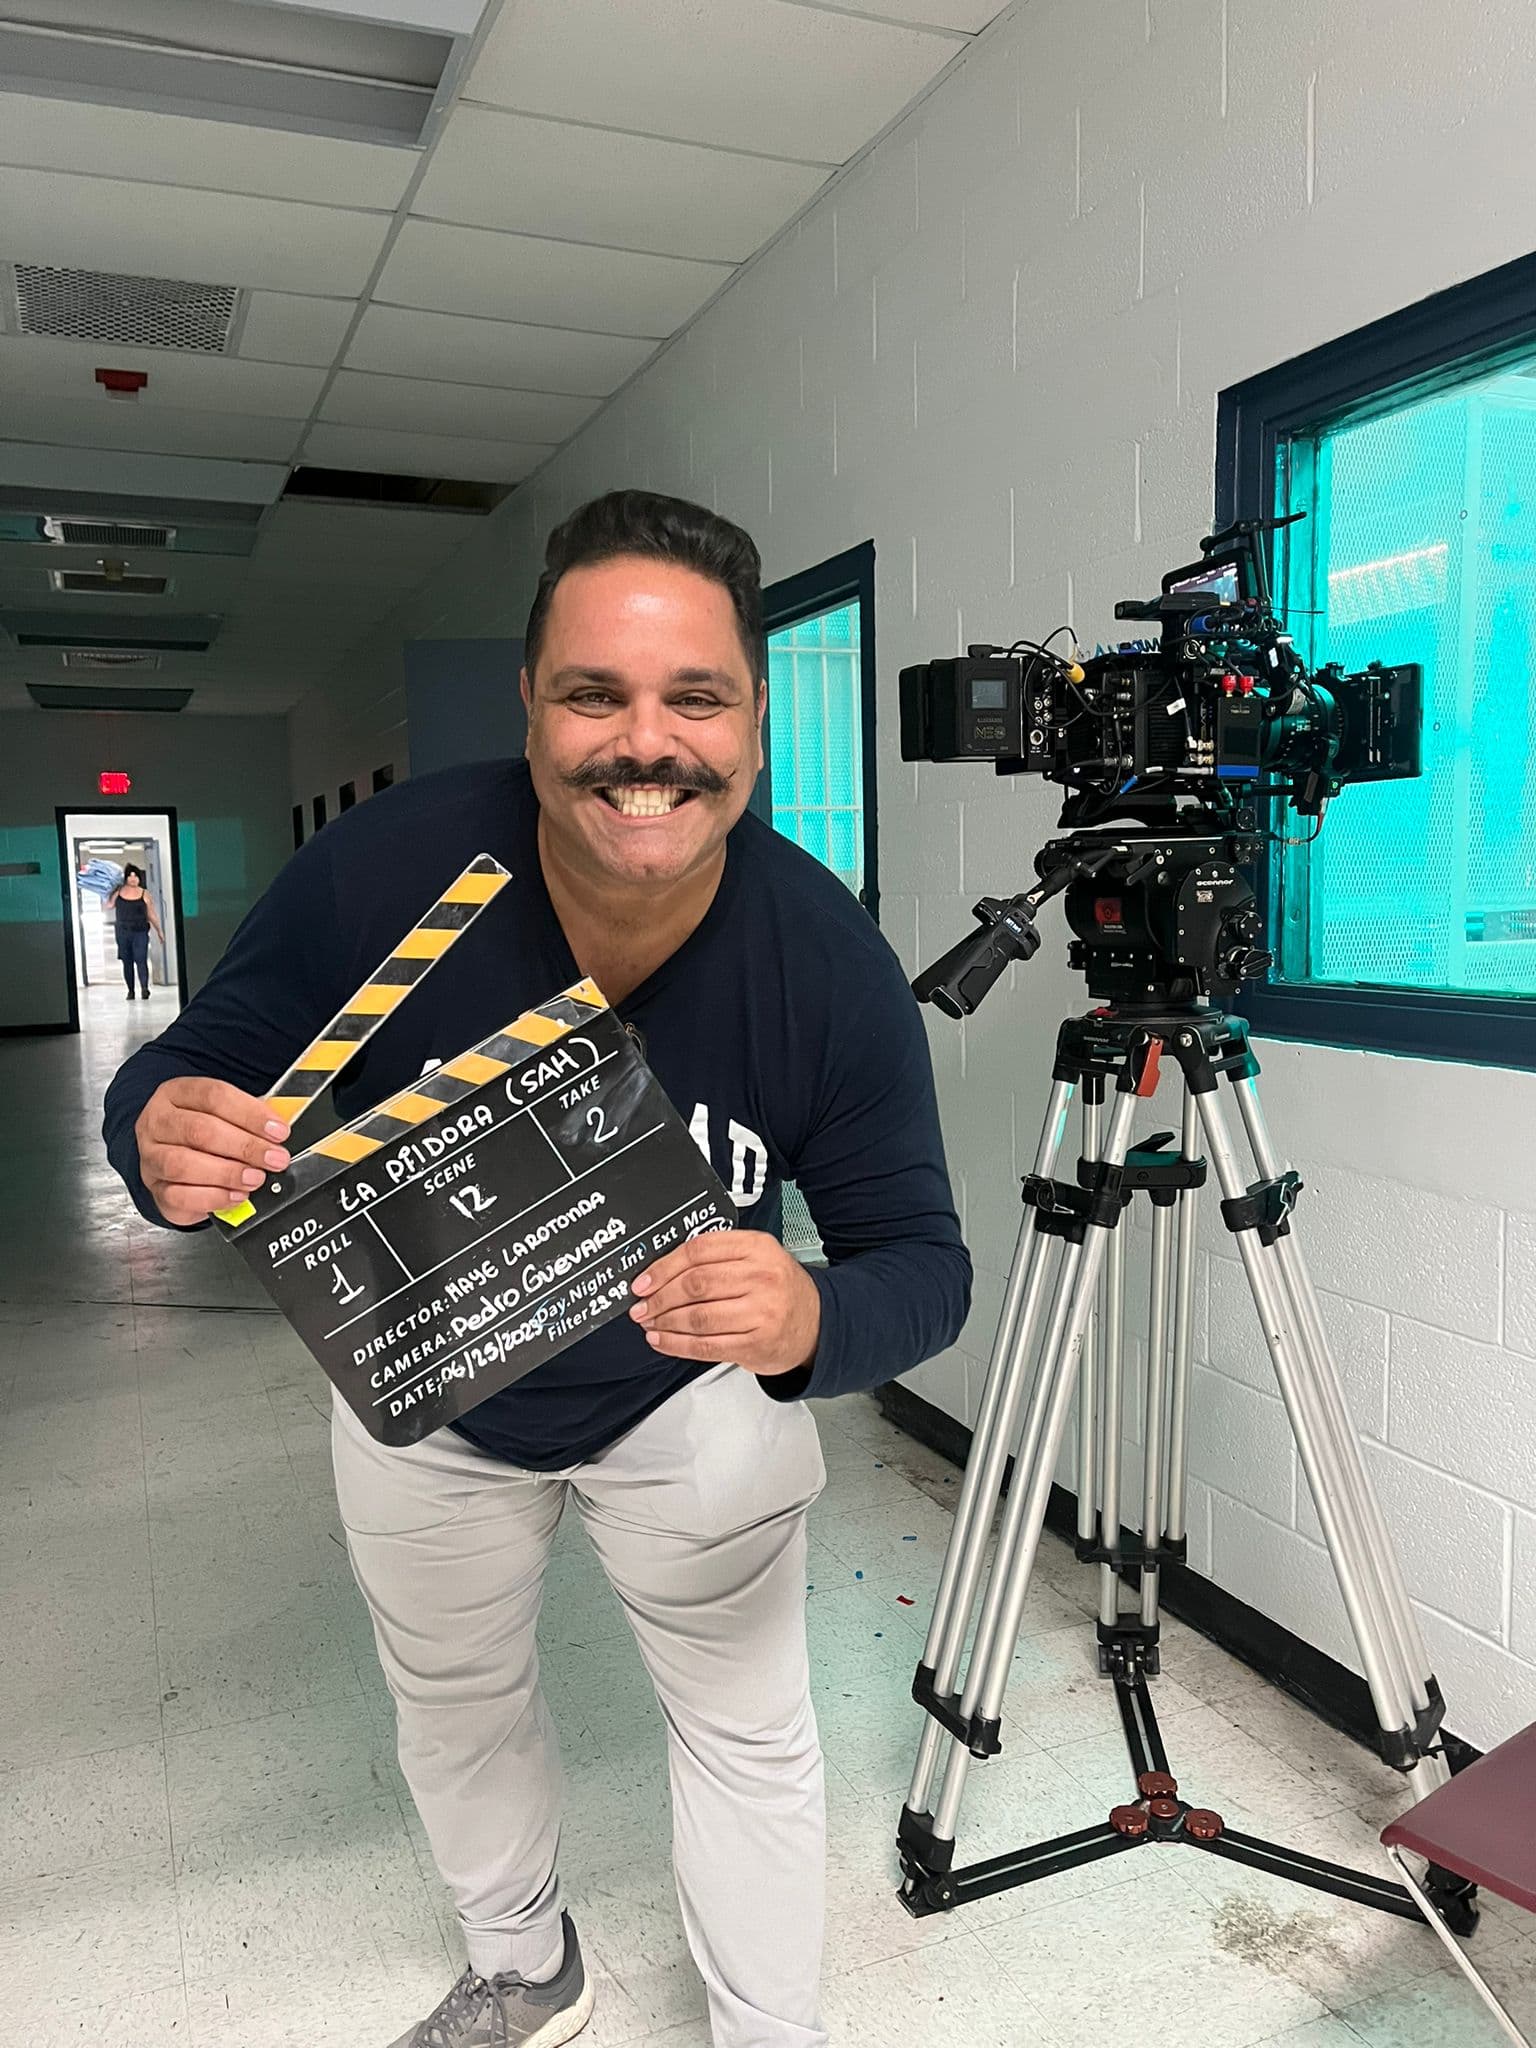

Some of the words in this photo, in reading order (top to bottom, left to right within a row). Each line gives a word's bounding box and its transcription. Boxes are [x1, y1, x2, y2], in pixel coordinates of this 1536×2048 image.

[558, 1074, 600, 1109] TAKE
[585, 1106, 619, 1143] 2
[423, 1152, 476, 1195] SCENE
[448, 1183, 497, 1220] 12
[267, 1218, 323, 1258] PROD.
[651, 1225, 678, 1250] Ext
[682, 1202, 716, 1231] Mos
[303, 1232, 352, 1270] ROLL
[331, 1262, 365, 1304] 1
[352, 1297, 450, 1366] DIRECTOR:
[370, 1330, 452, 1388] CAMERA:
[449, 1287, 520, 1338] Pedro
[547, 1307, 588, 1342] Filter
